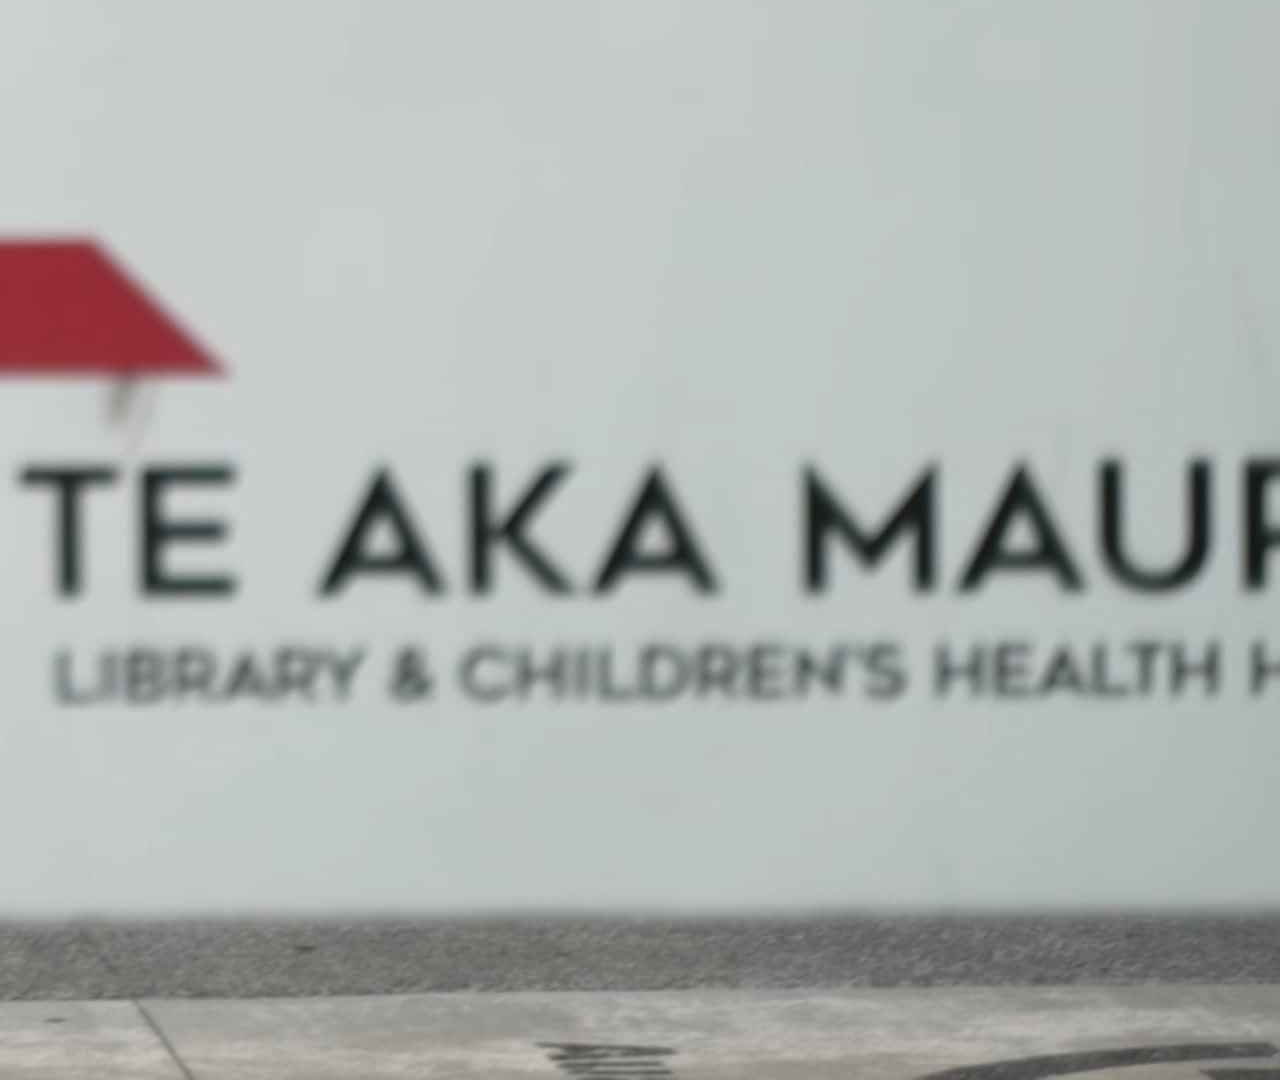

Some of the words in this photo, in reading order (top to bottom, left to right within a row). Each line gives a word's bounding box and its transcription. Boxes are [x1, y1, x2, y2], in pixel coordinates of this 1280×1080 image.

[20, 465, 234, 596] TE
[318, 463, 717, 596] AKA
[54, 645, 364, 705] LIBRARY
[387, 645, 434, 703] &
[458, 641, 909, 703] CHILDREN'S
[931, 639, 1224, 700] HEALTH
